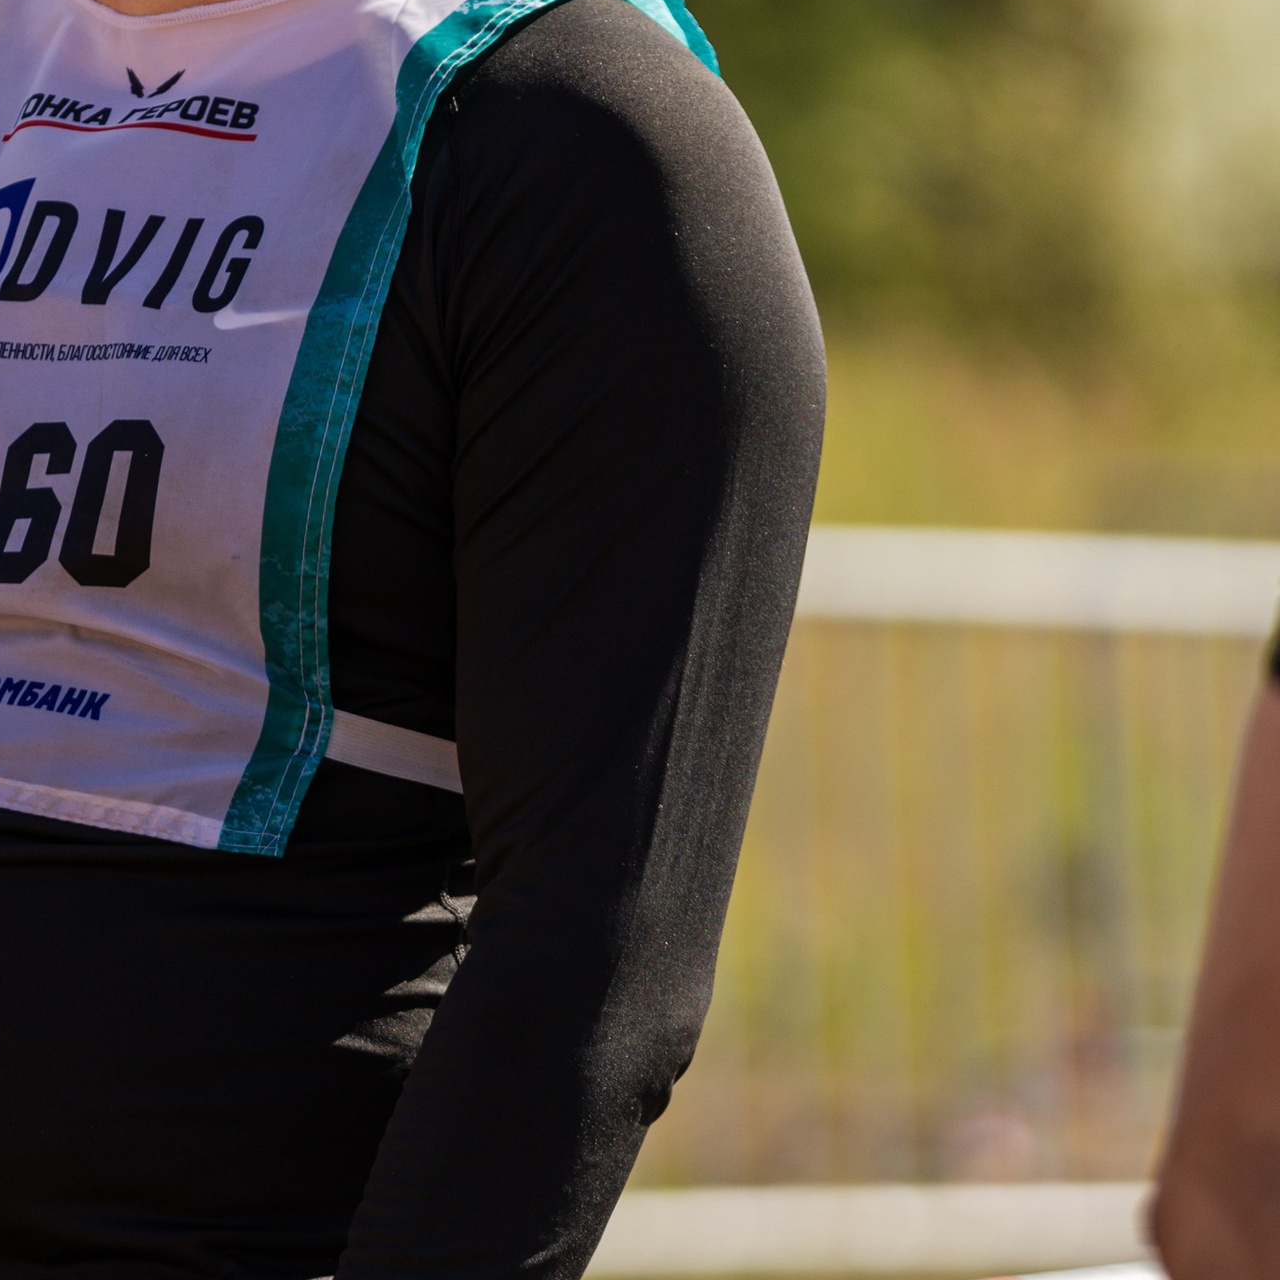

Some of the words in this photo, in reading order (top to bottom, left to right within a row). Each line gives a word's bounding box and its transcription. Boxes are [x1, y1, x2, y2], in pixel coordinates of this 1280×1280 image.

[14, 93, 112, 126] ОНКА
[118, 95, 260, 130] ГЕРОЕВ
[57, 342, 155, 362] БЛАГОСОСТОЯНИЕ
[151, 345, 182, 362] ДЛЯ
[179, 345, 212, 363] ВСЕХ
